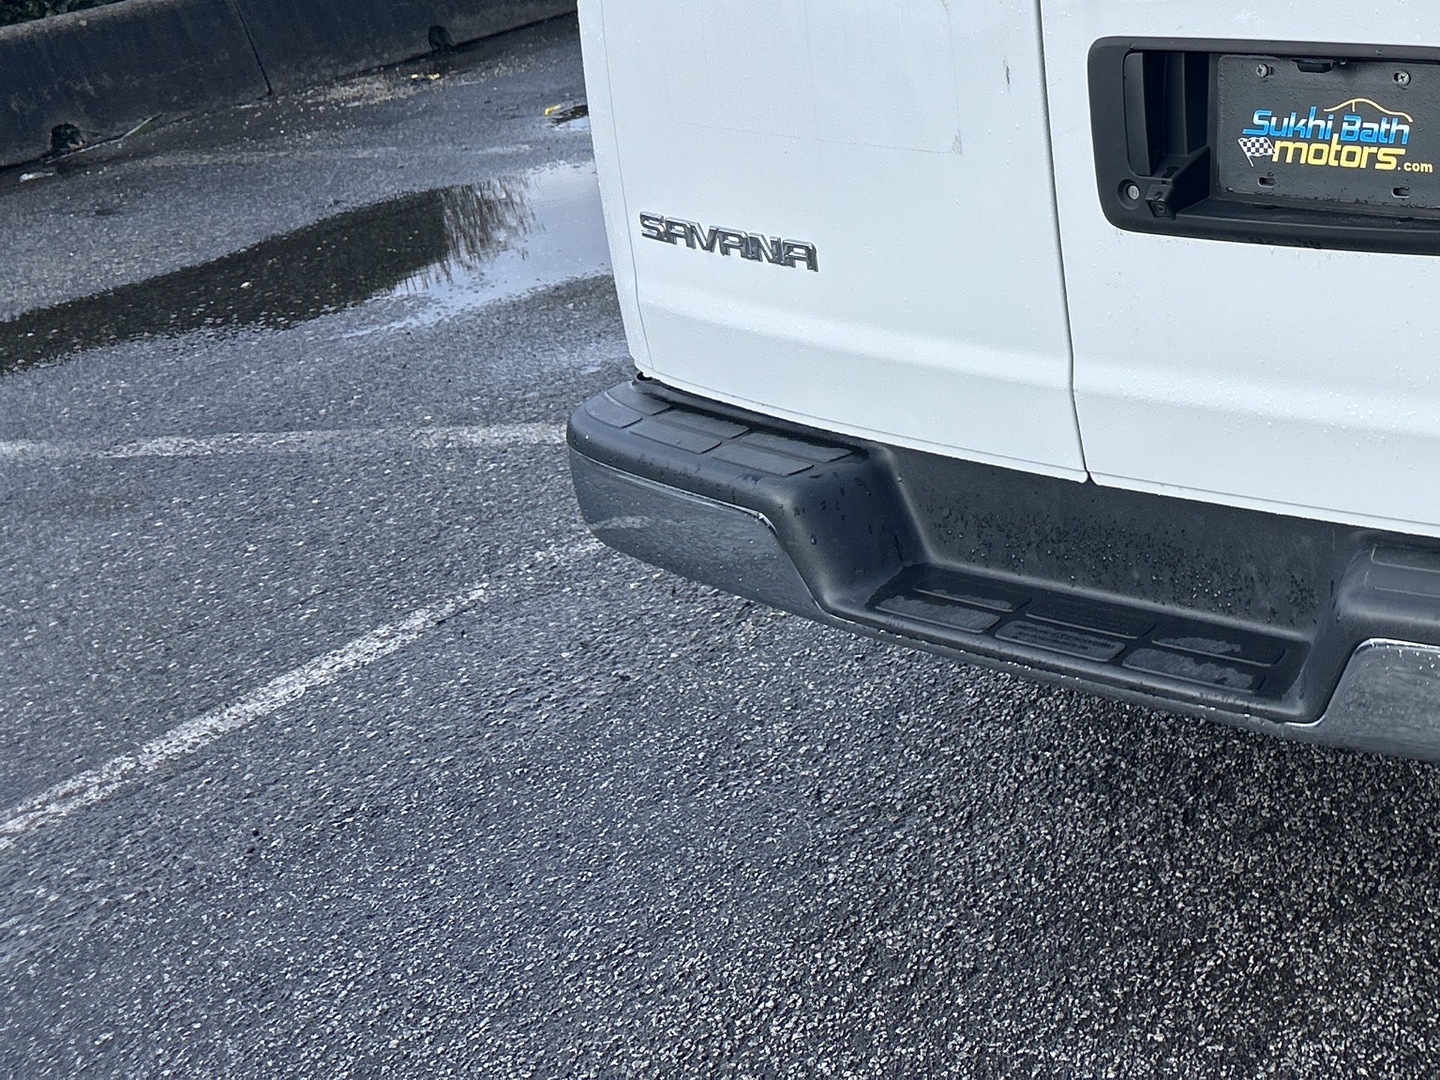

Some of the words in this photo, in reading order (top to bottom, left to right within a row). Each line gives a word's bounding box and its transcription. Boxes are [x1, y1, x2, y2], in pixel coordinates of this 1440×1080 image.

[1242, 106, 1334, 139] Sukhi
[1341, 114, 1410, 145] Bath
[639, 210, 819, 272] SAVANA
